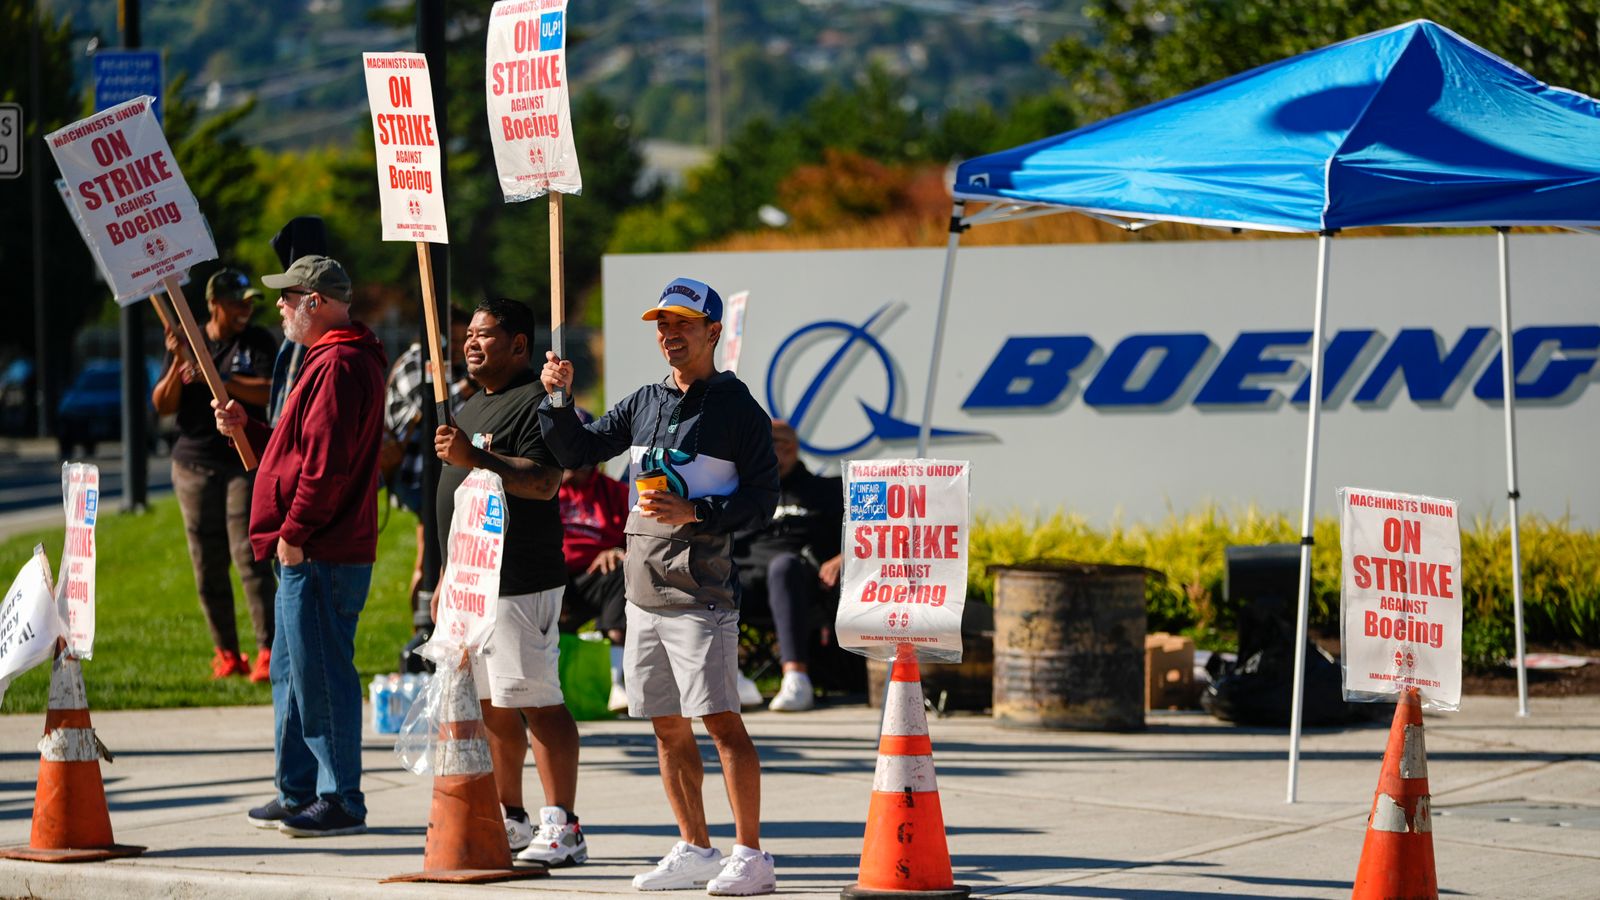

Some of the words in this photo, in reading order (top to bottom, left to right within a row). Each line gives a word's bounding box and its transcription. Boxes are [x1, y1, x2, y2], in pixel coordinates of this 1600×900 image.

[514, 18, 540, 54] ON
[542, 20, 560, 38] ULP!
[366, 58, 408, 69] MACHINISTS
[408, 58, 426, 70] UNION
[492, 54, 562, 96] STRIKE
[388, 76, 412, 108] ON
[511, 96, 544, 112] AGAINST
[53, 112, 115, 148] MACHINISTS
[116, 102, 146, 122] UNION
[376, 113, 434, 146] STRIKE
[502, 112, 560, 142] Boeing
[90, 129, 132, 167] ON
[396, 150, 422, 164] AGAINST
[78, 150, 174, 211] STRIKE
[388, 165, 432, 194] Boeing
[114, 190, 158, 218] AGAINST
[106, 200, 182, 246] Boeing
[960, 325, 1600, 409] BOEING
[852, 466, 924, 476] MACHINISTS
[927, 466, 964, 476] UNION
[857, 484, 880, 494] UNFAIR
[858, 494, 878, 504] LABOR
[887, 484, 926, 518] ON
[1350, 494, 1418, 512] MACHINISTS
[1420, 502, 1453, 518] UNION
[452, 532, 499, 570] STRIKE
[854, 525, 959, 559] STRIKE
[1383, 517, 1421, 555] ON
[880, 564, 932, 578] AGAINST
[1353, 554, 1454, 599] STRIKE
[861, 580, 946, 607] Boeing
[1380, 596, 1428, 615] AGAINST
[1364, 610, 1443, 649] Boeing
